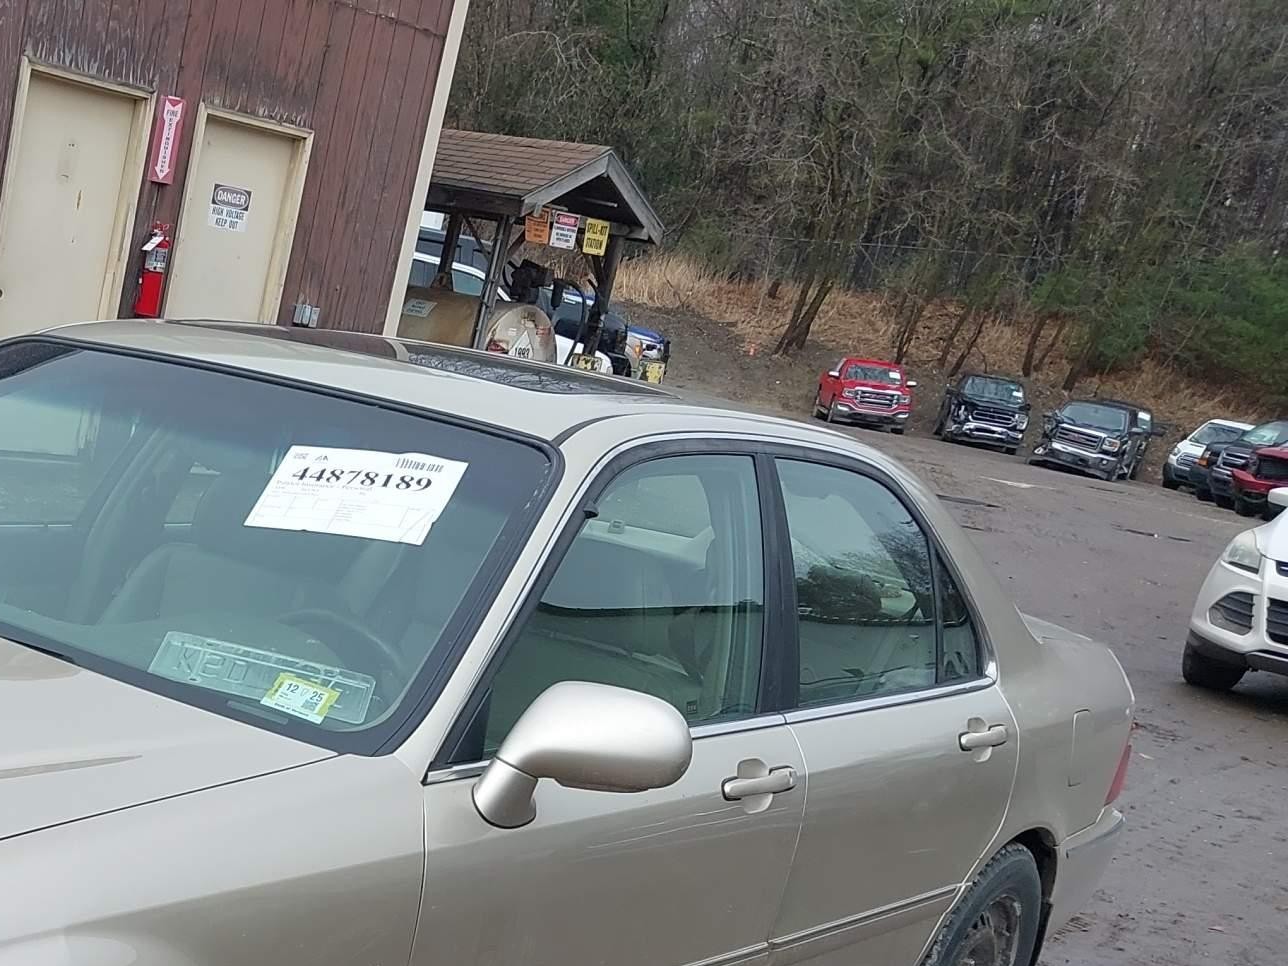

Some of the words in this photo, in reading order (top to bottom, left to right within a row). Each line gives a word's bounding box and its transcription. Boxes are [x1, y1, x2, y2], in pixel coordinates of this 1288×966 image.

[166, 109, 179, 118] FIRE
[217, 190, 246, 206] DANGER
[212, 206, 224, 217] HIGH
[225, 208, 245, 221] VOLTAGE
[215, 217, 228, 227] KEEP
[228, 220, 239, 230] OUT
[292, 466, 433, 492] 44878189
[286, 682, 300, 694] 12
[309, 690, 326, 702] 25
